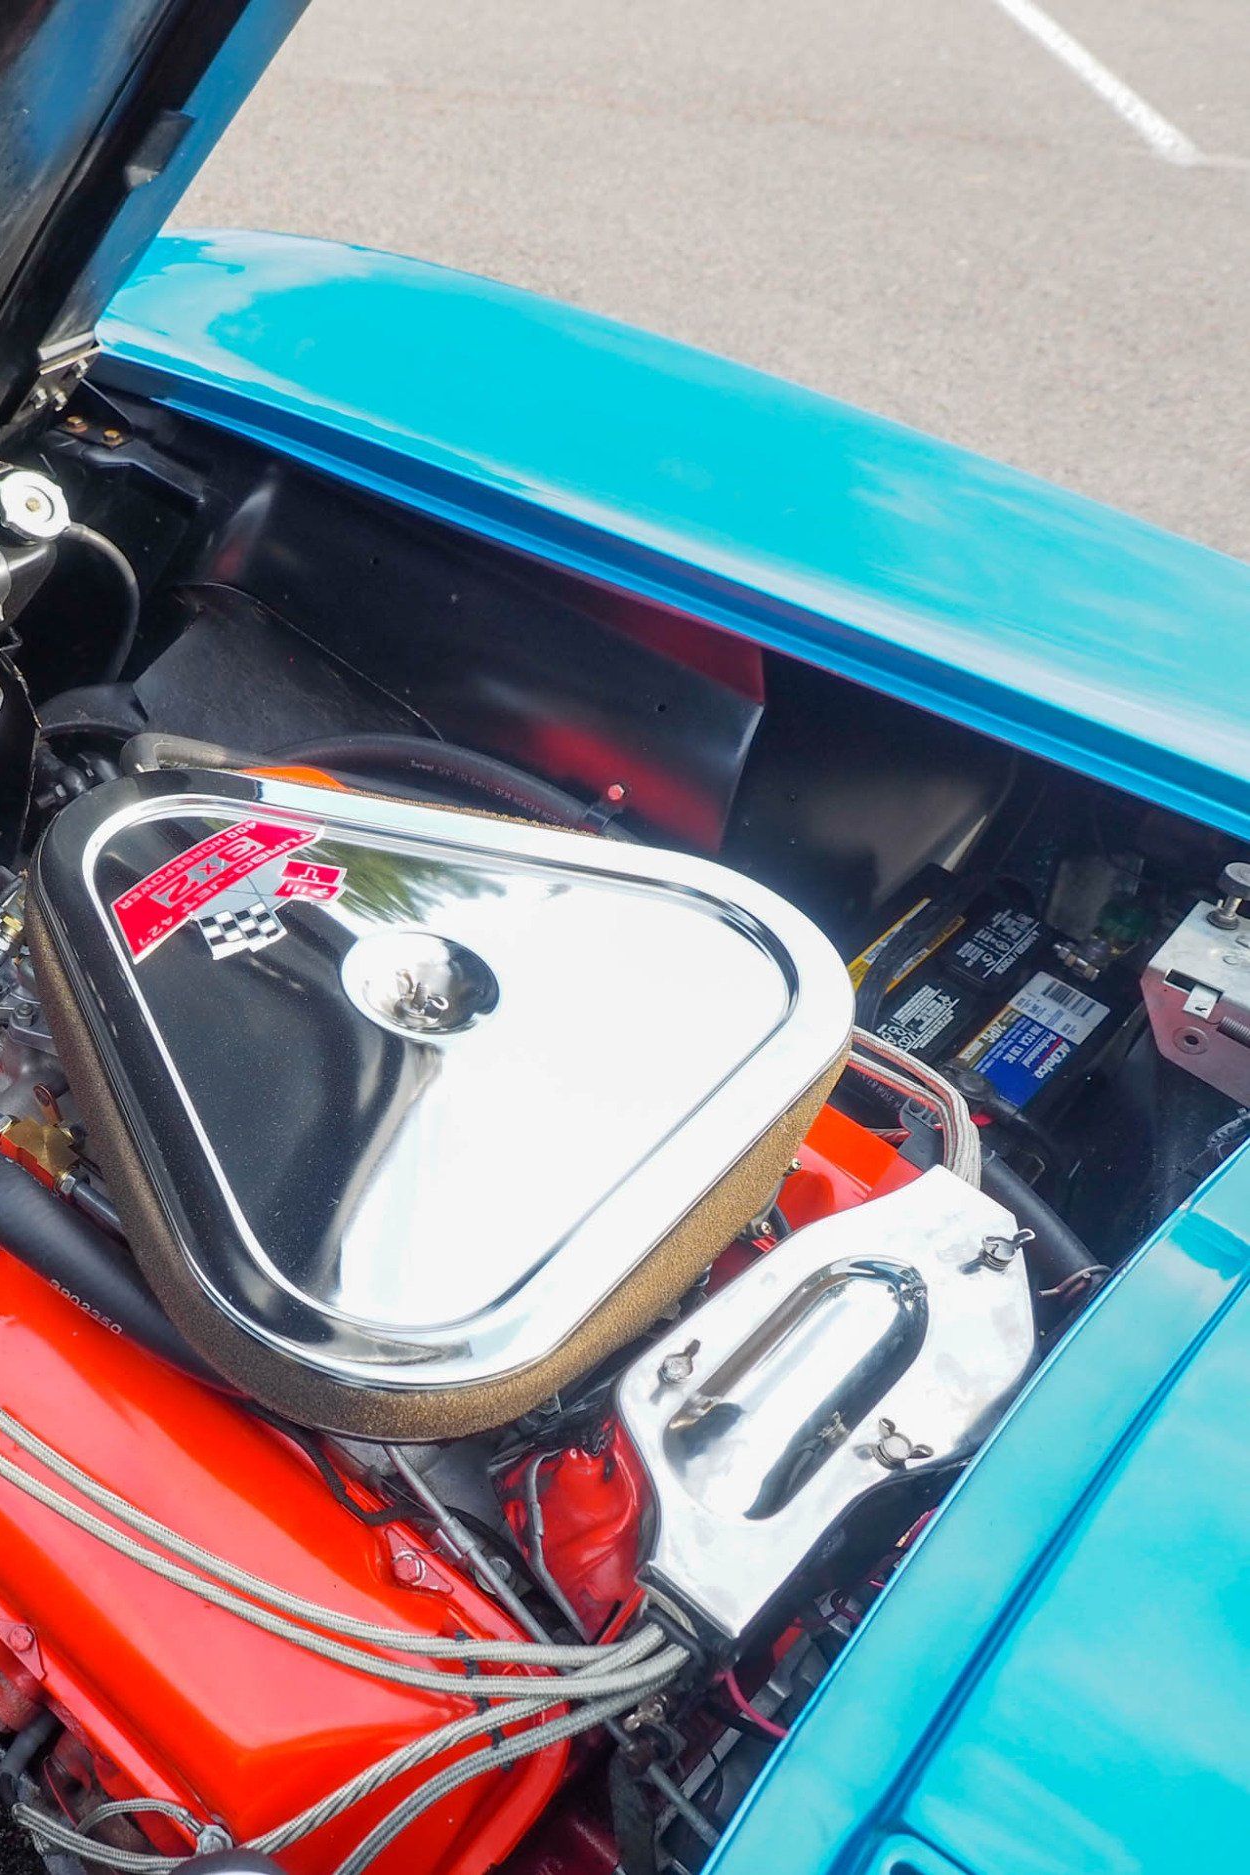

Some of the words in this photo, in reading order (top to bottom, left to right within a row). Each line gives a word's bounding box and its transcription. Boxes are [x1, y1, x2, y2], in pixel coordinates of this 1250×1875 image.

[226, 821, 258, 839] 400
[120, 837, 227, 910] HORSEPOWER
[181, 831, 315, 914] TURBO-JET
[137, 916, 174, 948] 427
[1021, 1033, 1037, 1047] CCA
[1021, 1031, 1058, 1069] Professional
[1034, 1041, 1072, 1079] ACDelco
